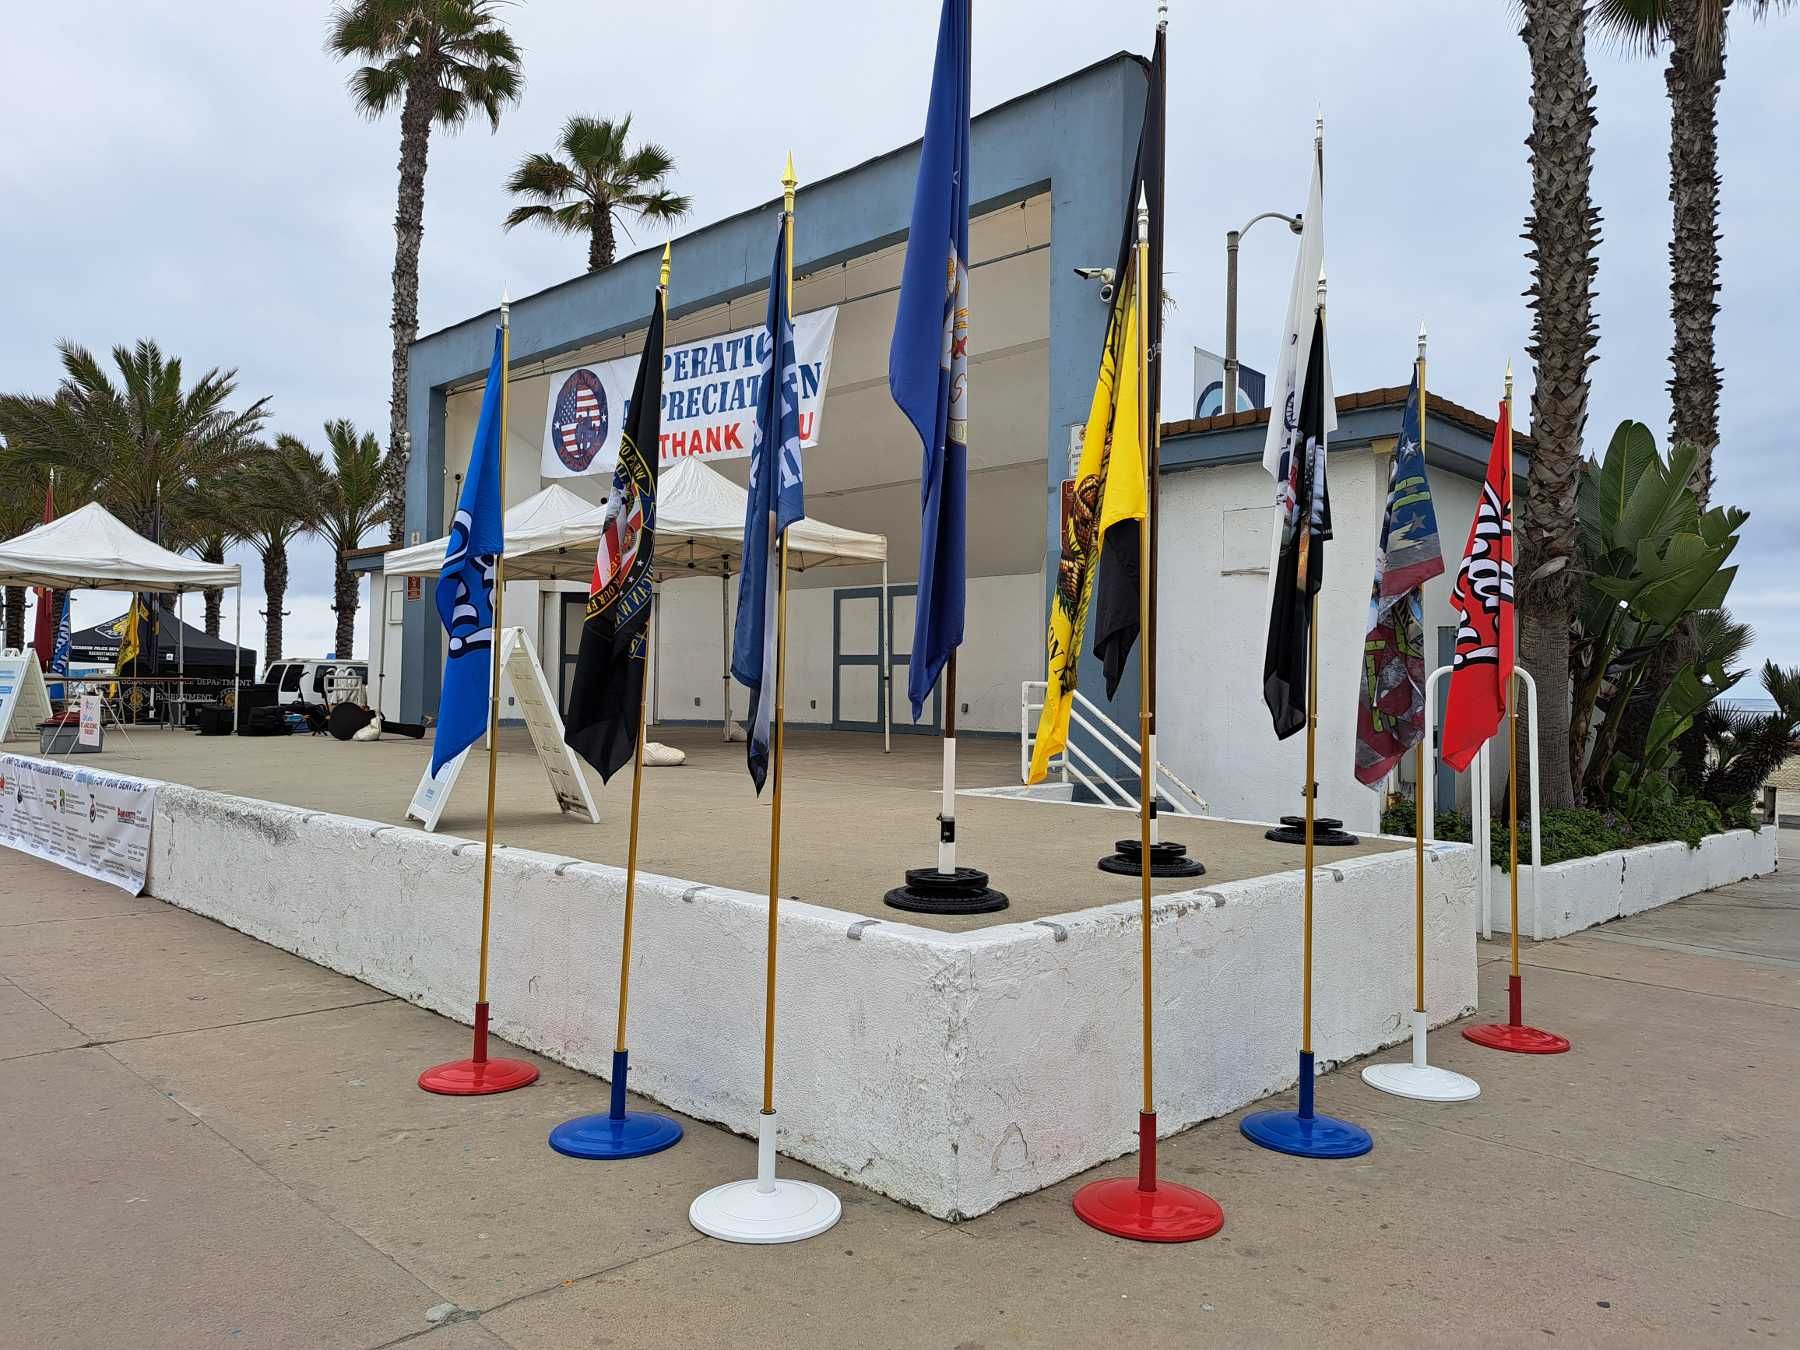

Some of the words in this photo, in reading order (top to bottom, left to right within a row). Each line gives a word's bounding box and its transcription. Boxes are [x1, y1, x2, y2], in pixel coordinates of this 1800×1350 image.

[664, 324, 796, 382] ERATIO
[622, 362, 822, 430] ARECIATN
[658, 422, 744, 459] THANK
[196, 678, 252, 687] DEPARTMNT
[118, 780, 143, 793] SERVICE
